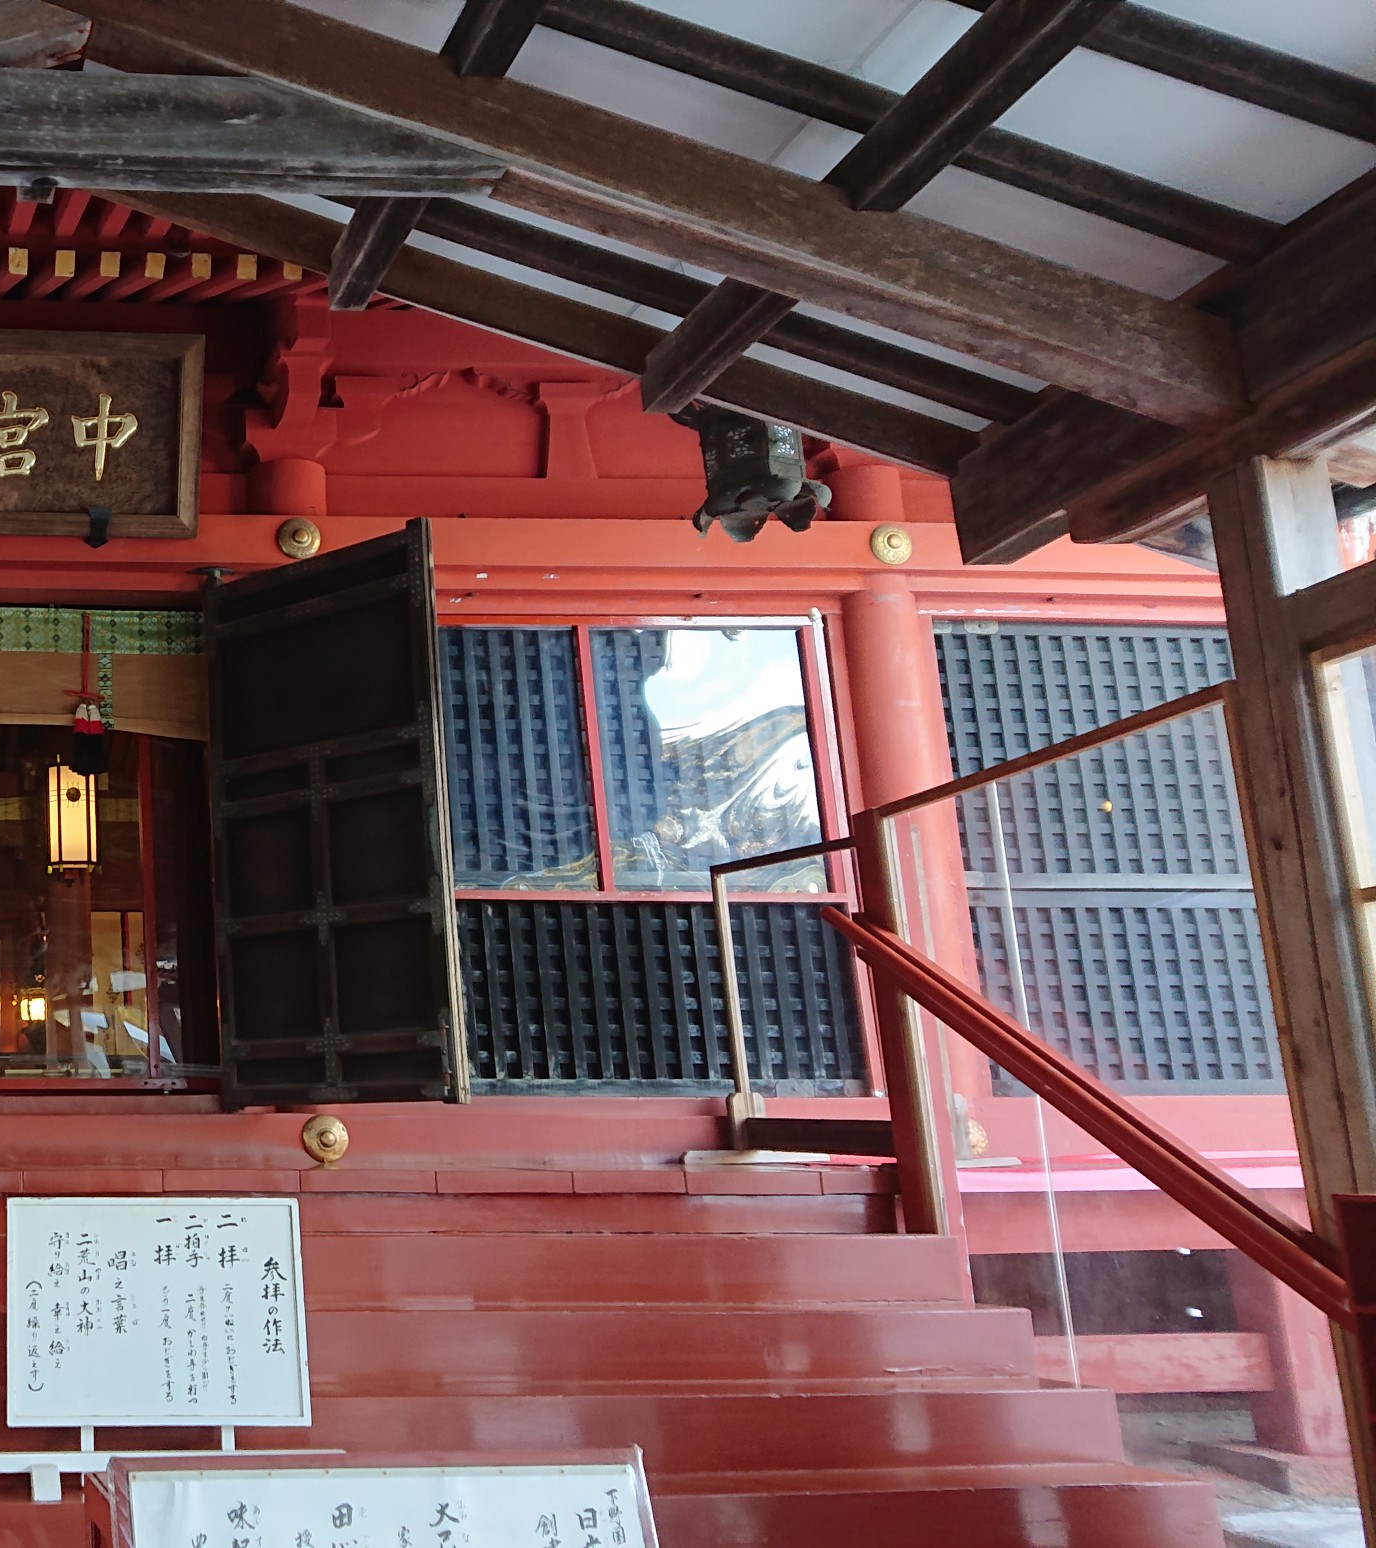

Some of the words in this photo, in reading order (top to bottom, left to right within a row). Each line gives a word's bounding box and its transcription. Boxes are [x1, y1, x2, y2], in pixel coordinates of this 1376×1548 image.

[153, 1217, 177, 1266] 一拝
[184, 1214, 204, 1268] 二拍手
[216, 1214, 241, 1269] 二拝
[75, 1233, 97, 1337] 二荒山の大神
[260, 1256, 288, 1355] 参拝の作法
